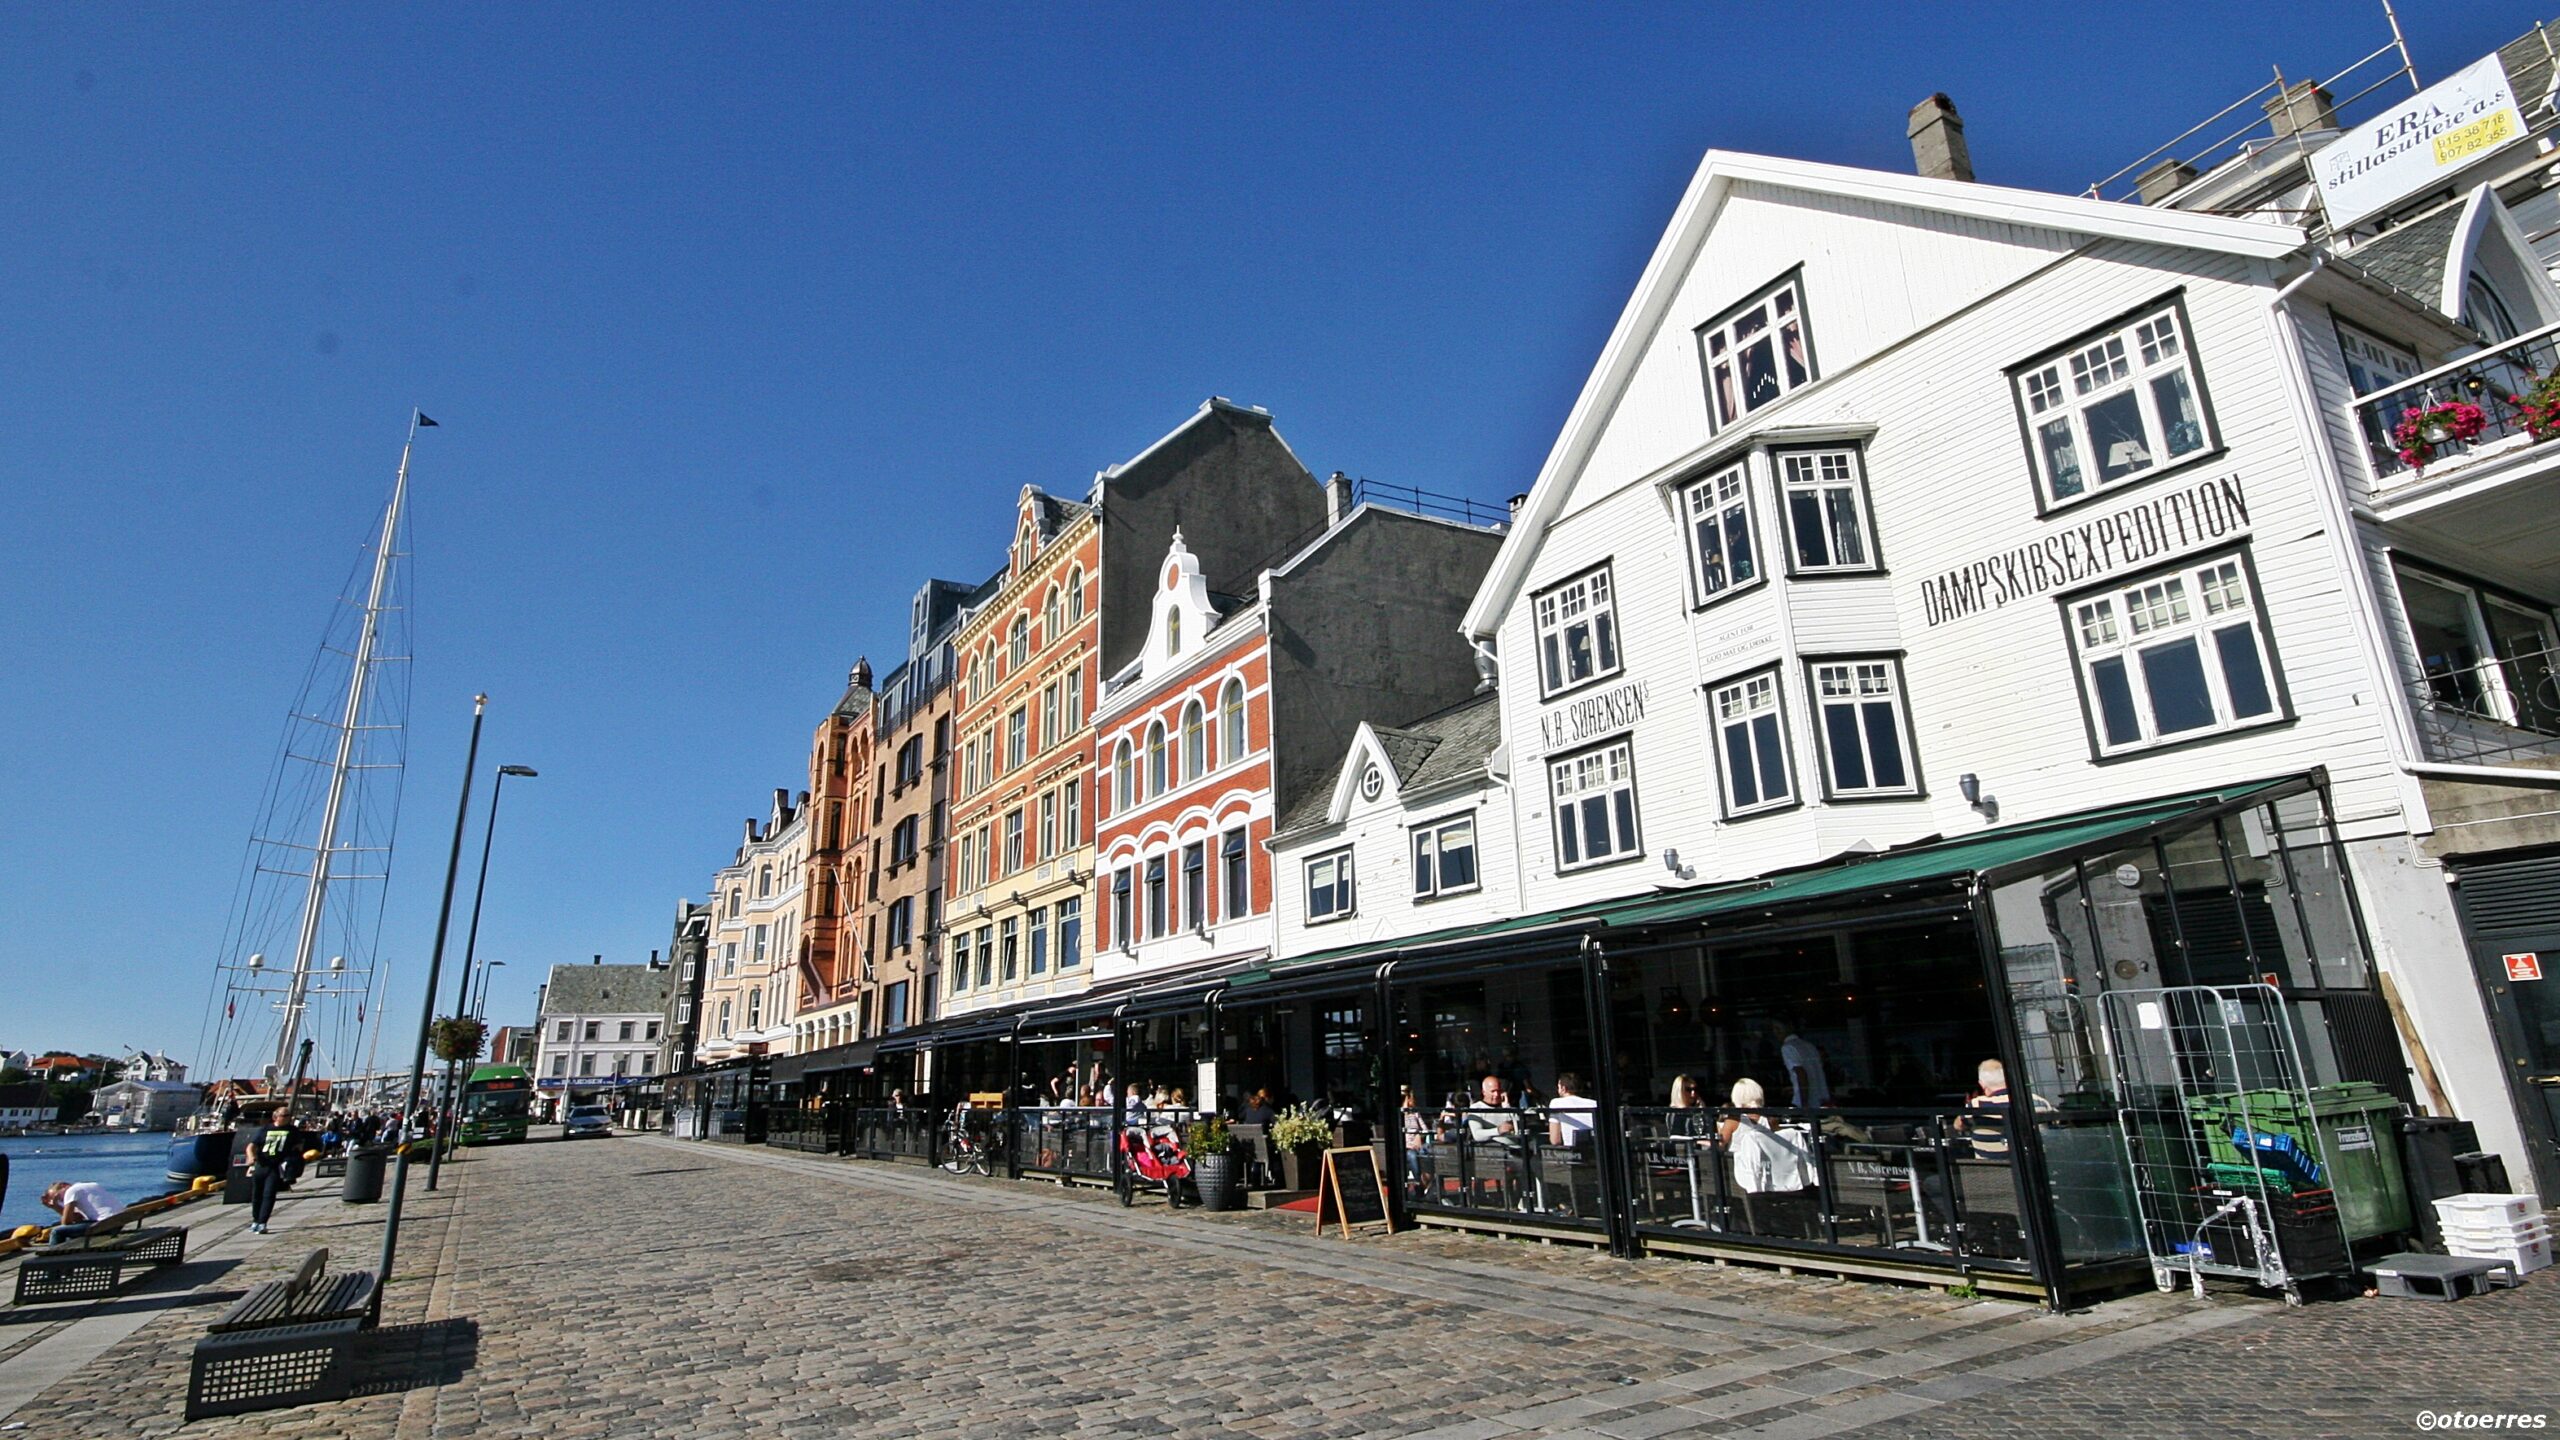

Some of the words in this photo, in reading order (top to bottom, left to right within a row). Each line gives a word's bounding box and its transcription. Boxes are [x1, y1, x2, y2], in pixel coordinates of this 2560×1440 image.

[2328, 111, 2465, 190] stillasutleie
[2472, 90, 2506, 116] a.s
[2374, 101, 2445, 150] ERA
[2437, 133, 2461, 149] 915
[2464, 125, 2480, 138] 38
[2482, 113, 2506, 130] 718
[2440, 146, 2463, 161] 907
[2467, 138, 2482, 151] 82
[2486, 127, 2508, 142] 355
[1920, 473, 2251, 628] DAMPSKIBSEXPEDITION
[1540, 710, 1568, 751] N.B.
